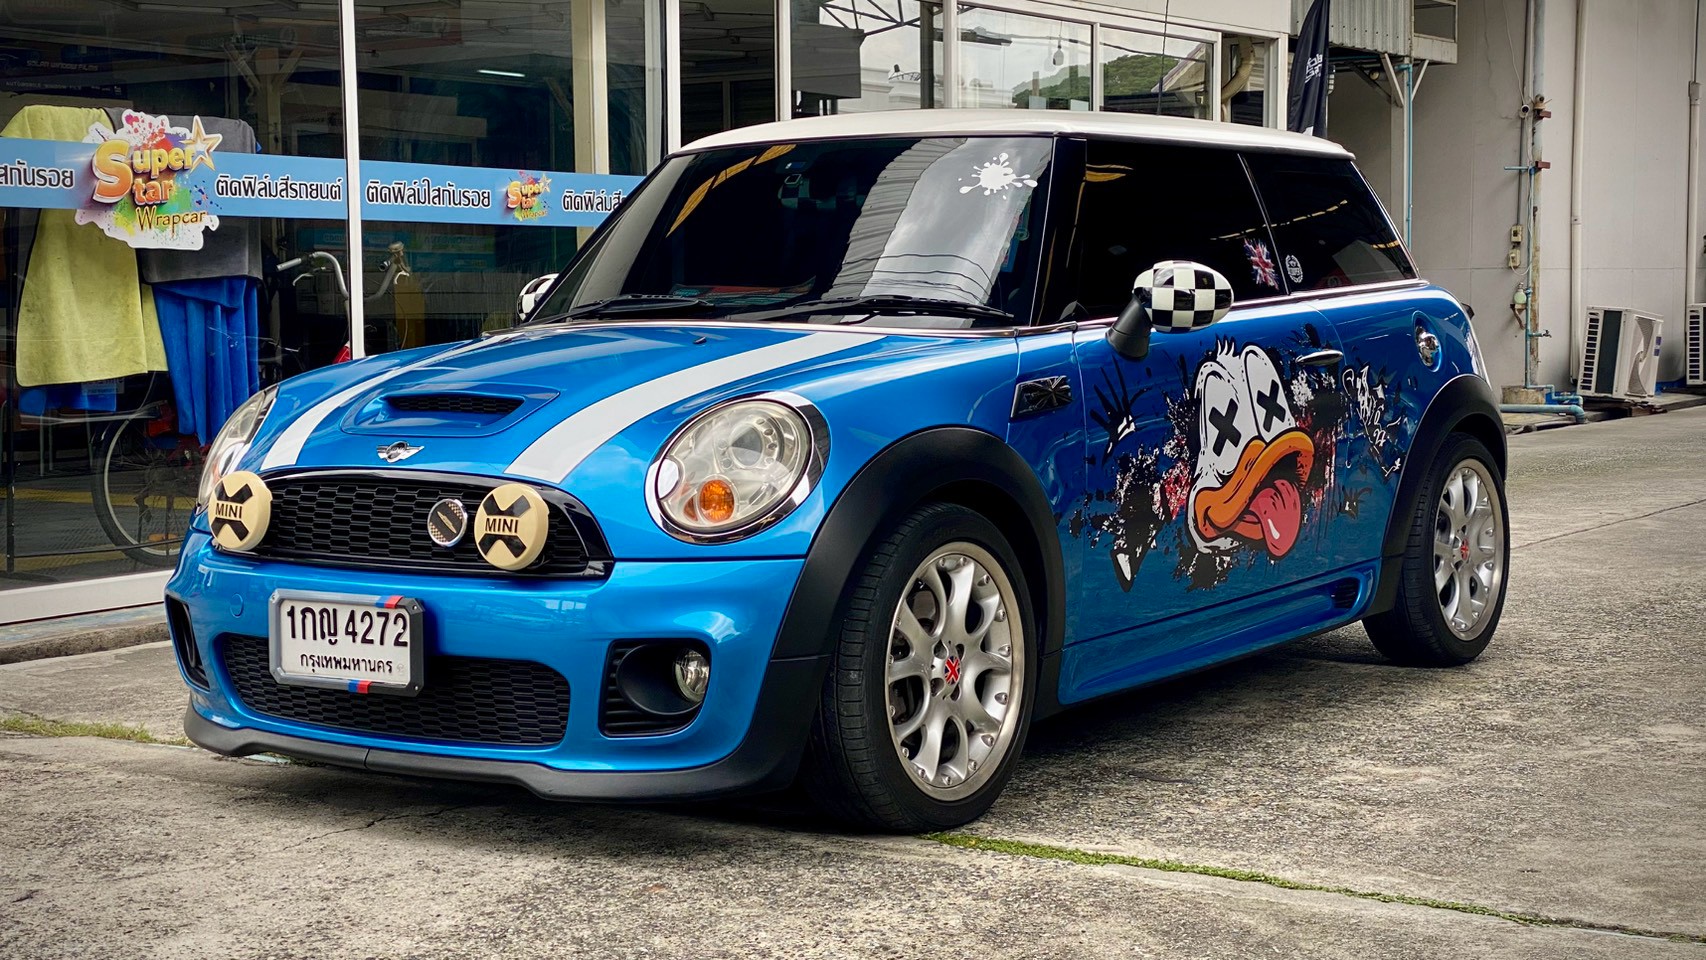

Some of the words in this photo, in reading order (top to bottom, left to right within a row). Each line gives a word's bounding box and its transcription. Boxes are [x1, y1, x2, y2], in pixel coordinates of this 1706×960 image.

[92, 139, 194, 203] Super
[216, 174, 343, 201] ติดฟิล์มสีรถยนต์
[366, 178, 491, 208] ติดฟิล์มใสกันรอย
[136, 205, 208, 239] Wrapcar
[215, 502, 243, 519] MINI
[485, 517, 518, 533] MINI
[287, 605, 338, 645] 1กญ
[344, 609, 408, 647] 4272
[300, 653, 393, 673] กรุงเทพมหานคร
